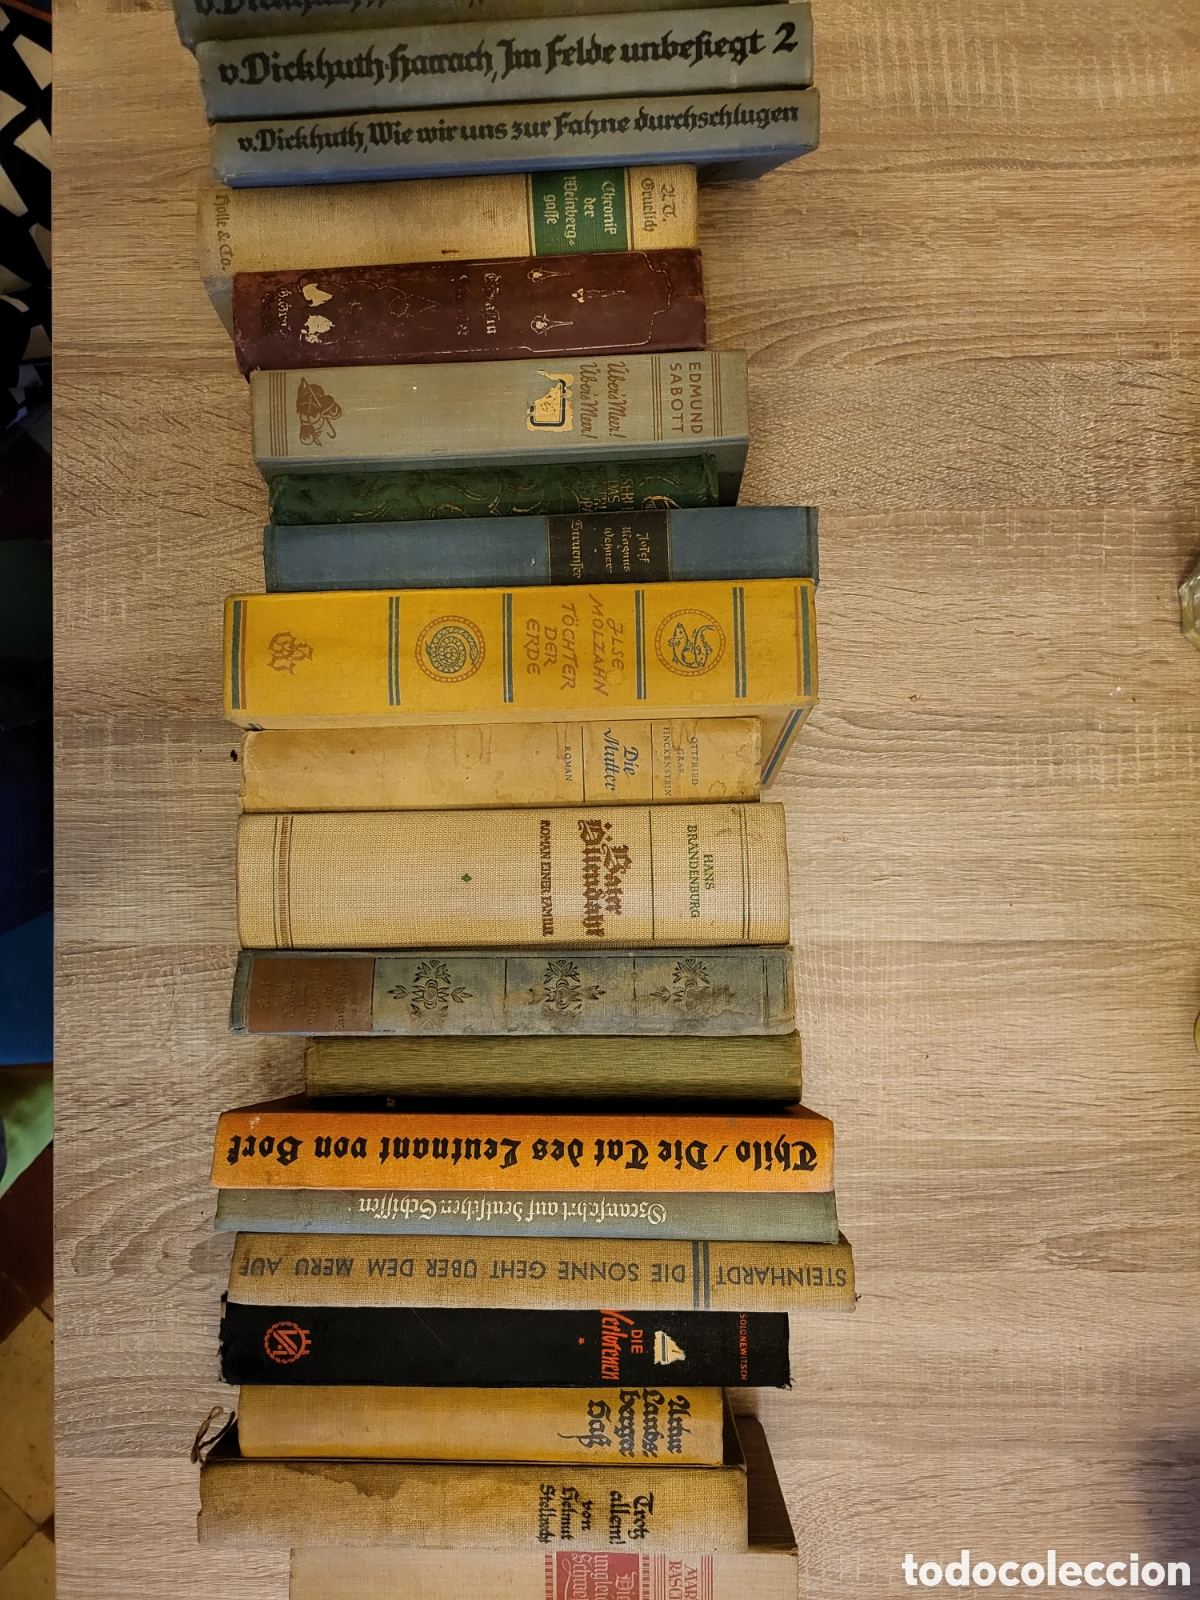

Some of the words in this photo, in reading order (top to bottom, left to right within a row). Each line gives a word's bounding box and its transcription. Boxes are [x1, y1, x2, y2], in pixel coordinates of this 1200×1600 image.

[496, 37, 542, 80] Im
[545, 33, 616, 75] Felde
[620, 28, 767, 68] unbesiegt
[771, 21, 800, 54] 2
[368, 119, 413, 147] Wie
[415, 118, 458, 144] wir
[459, 121, 508, 142] uns
[511, 117, 552, 141] zur
[552, 107, 630, 141] Fahne
[633, 103, 800, 133] durchschlugen
[213, 195, 231, 228] Holle
[543, 194, 559, 225] gasse
[583, 197, 596, 218] der
[601, 181, 617, 235] Chronik
[218, 231, 231, 242] &
[219, 244, 234, 271] Co.
[670, 363, 684, 433] SABOTT
[688, 362, 703, 434] EDMUND
[579, 401, 598, 439] Meer!
[607, 401, 627, 438] Meer!
[607, 480, 620, 503] DAS
[569, 519, 583, 579] Struensee
[603, 527, 614, 573] Wehner
[617, 527, 631, 572] Magnus
[636, 533, 650, 563] Josef
[523, 618, 541, 675] ERDE
[542, 626, 558, 667] DER
[560, 602, 579, 690] TÖCHTER
[589, 593, 609, 696] MOLZAHN
[564, 746, 573, 782] ROMAN
[603, 728, 620, 792] Mutter
[623, 746, 639, 775] Die
[662, 727, 672, 797] FINCKENSTEIN
[676, 748, 685, 774] GRAF
[690, 737, 699, 785] OTTFRIED
[539, 820, 552, 860] ROMAN
[540, 861, 552, 894] EINER
[687, 824, 700, 919] BRANDENBURG
[703, 854, 714, 890] HANS
[226, 1133, 304, 1166] Bork
[314, 1135, 368, 1162] von
[378, 1136, 522, 1169] Leutnant
[530, 1138, 584, 1169] des
[594, 1137, 648, 1170] Tat
[658, 1138, 710, 1171] Die
[735, 1132, 818, 1172] Thilo
[358, 1194, 437, 1220] Schiffen
[440, 1196, 523, 1223] deutschen
[525, 1198, 558, 1223] auf
[562, 1196, 667, 1225] Ozeanfahrt
[238, 1256, 282, 1277] AUF
[294, 1258, 354, 1278] MERU
[368, 1258, 414, 1278] DEM
[489, 1260, 546, 1280] GEHT
[558, 1261, 640, 1282] SONNE
[651, 1263, 686, 1284] DIE
[716, 1265, 847, 1287] STEINHARDT
[599, 1309, 635, 1381] Verlorenen
[630, 1329, 643, 1354] DIE
[739, 1313, 748, 1381] SOLONEWITSCH
[613, 1389, 640, 1458] berger
[667, 1395, 692, 1454] Artur
[535, 1483, 557, 1544] Stellrecht
[560, 1486, 580, 1541] Helmut
[581, 1500, 594, 1531] von
[608, 1490, 632, 1545] allem!
[627, 1492, 654, 1540] Trotz
[570, 1553, 593, 1600] Schwe
